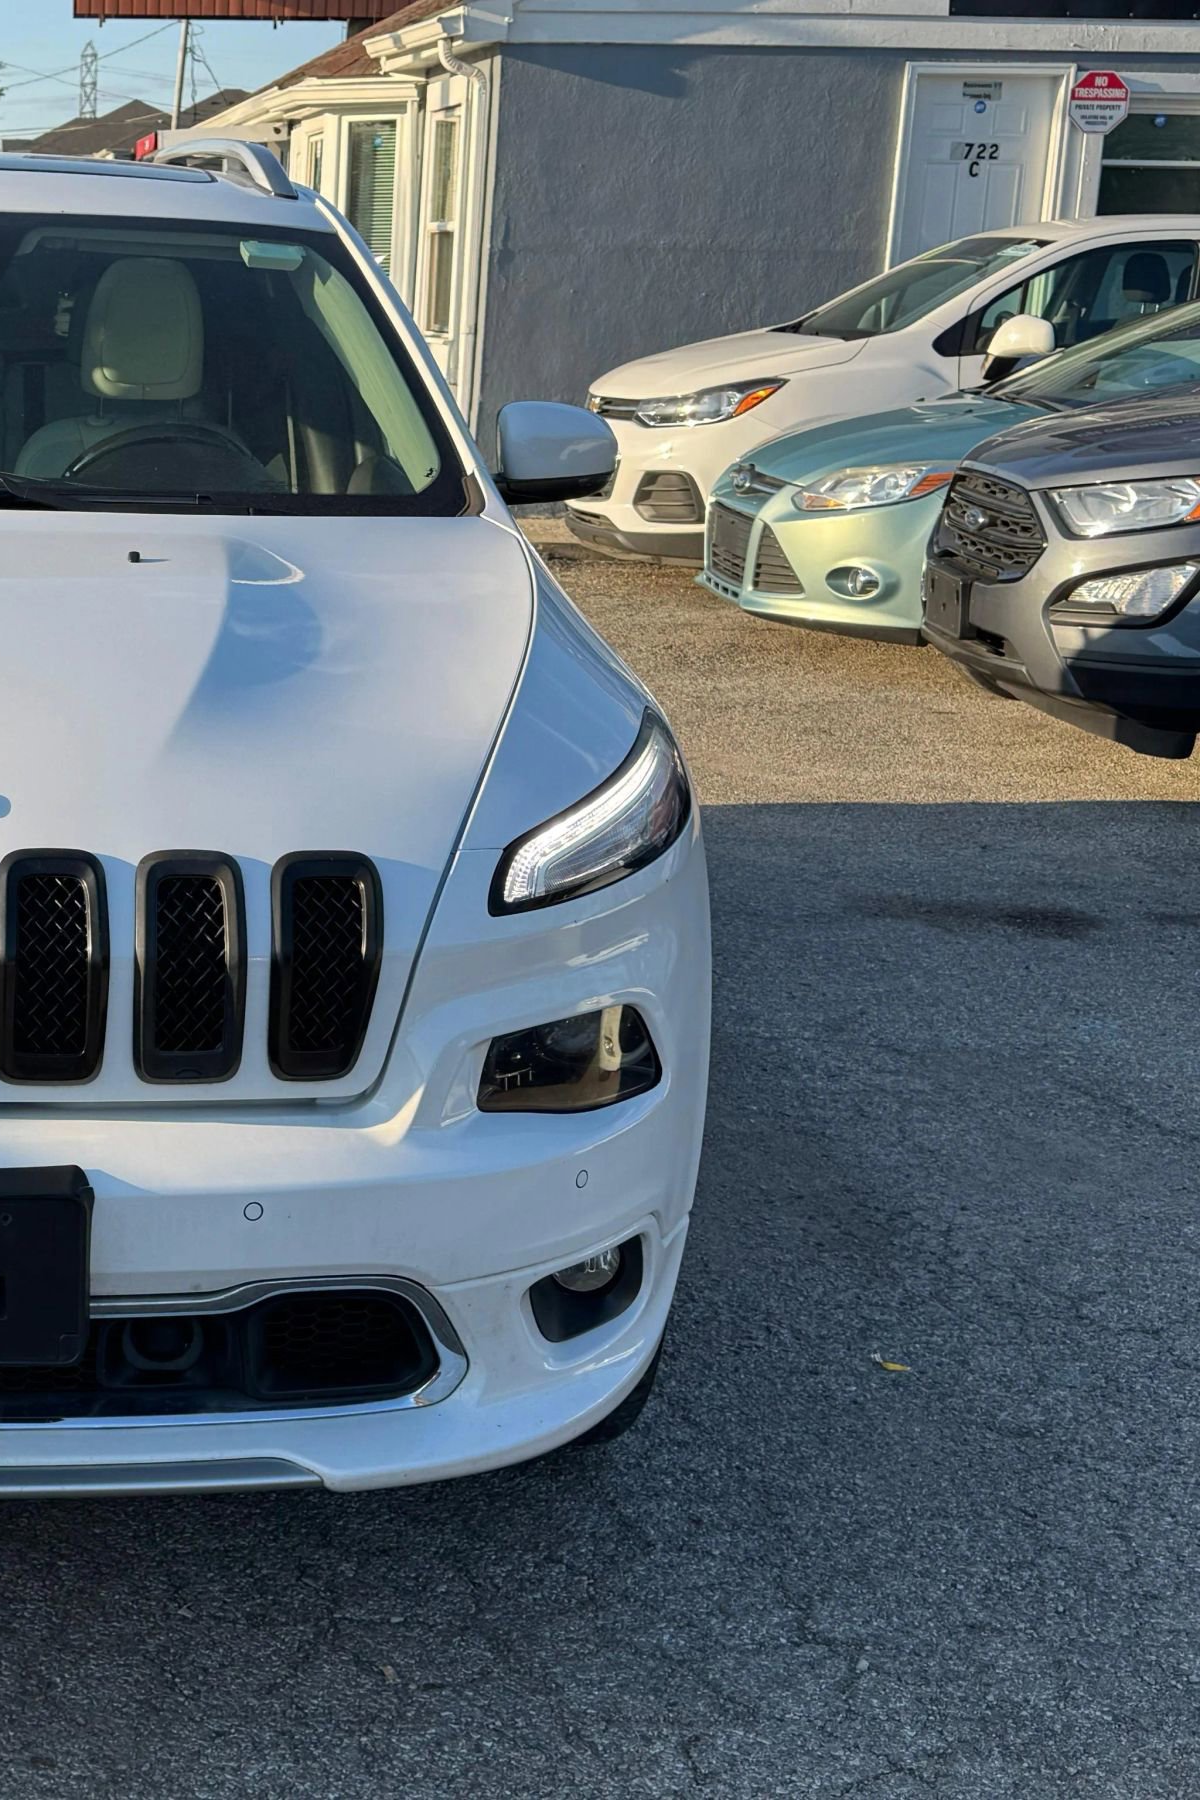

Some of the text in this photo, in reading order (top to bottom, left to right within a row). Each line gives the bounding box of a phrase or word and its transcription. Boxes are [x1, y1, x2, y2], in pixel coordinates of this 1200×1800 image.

[1094, 76, 1109, 87] NO
[1074, 87, 1127, 99] TRESPASSING
[962, 143, 1000, 160] 722
[968, 161, 980, 178] C
